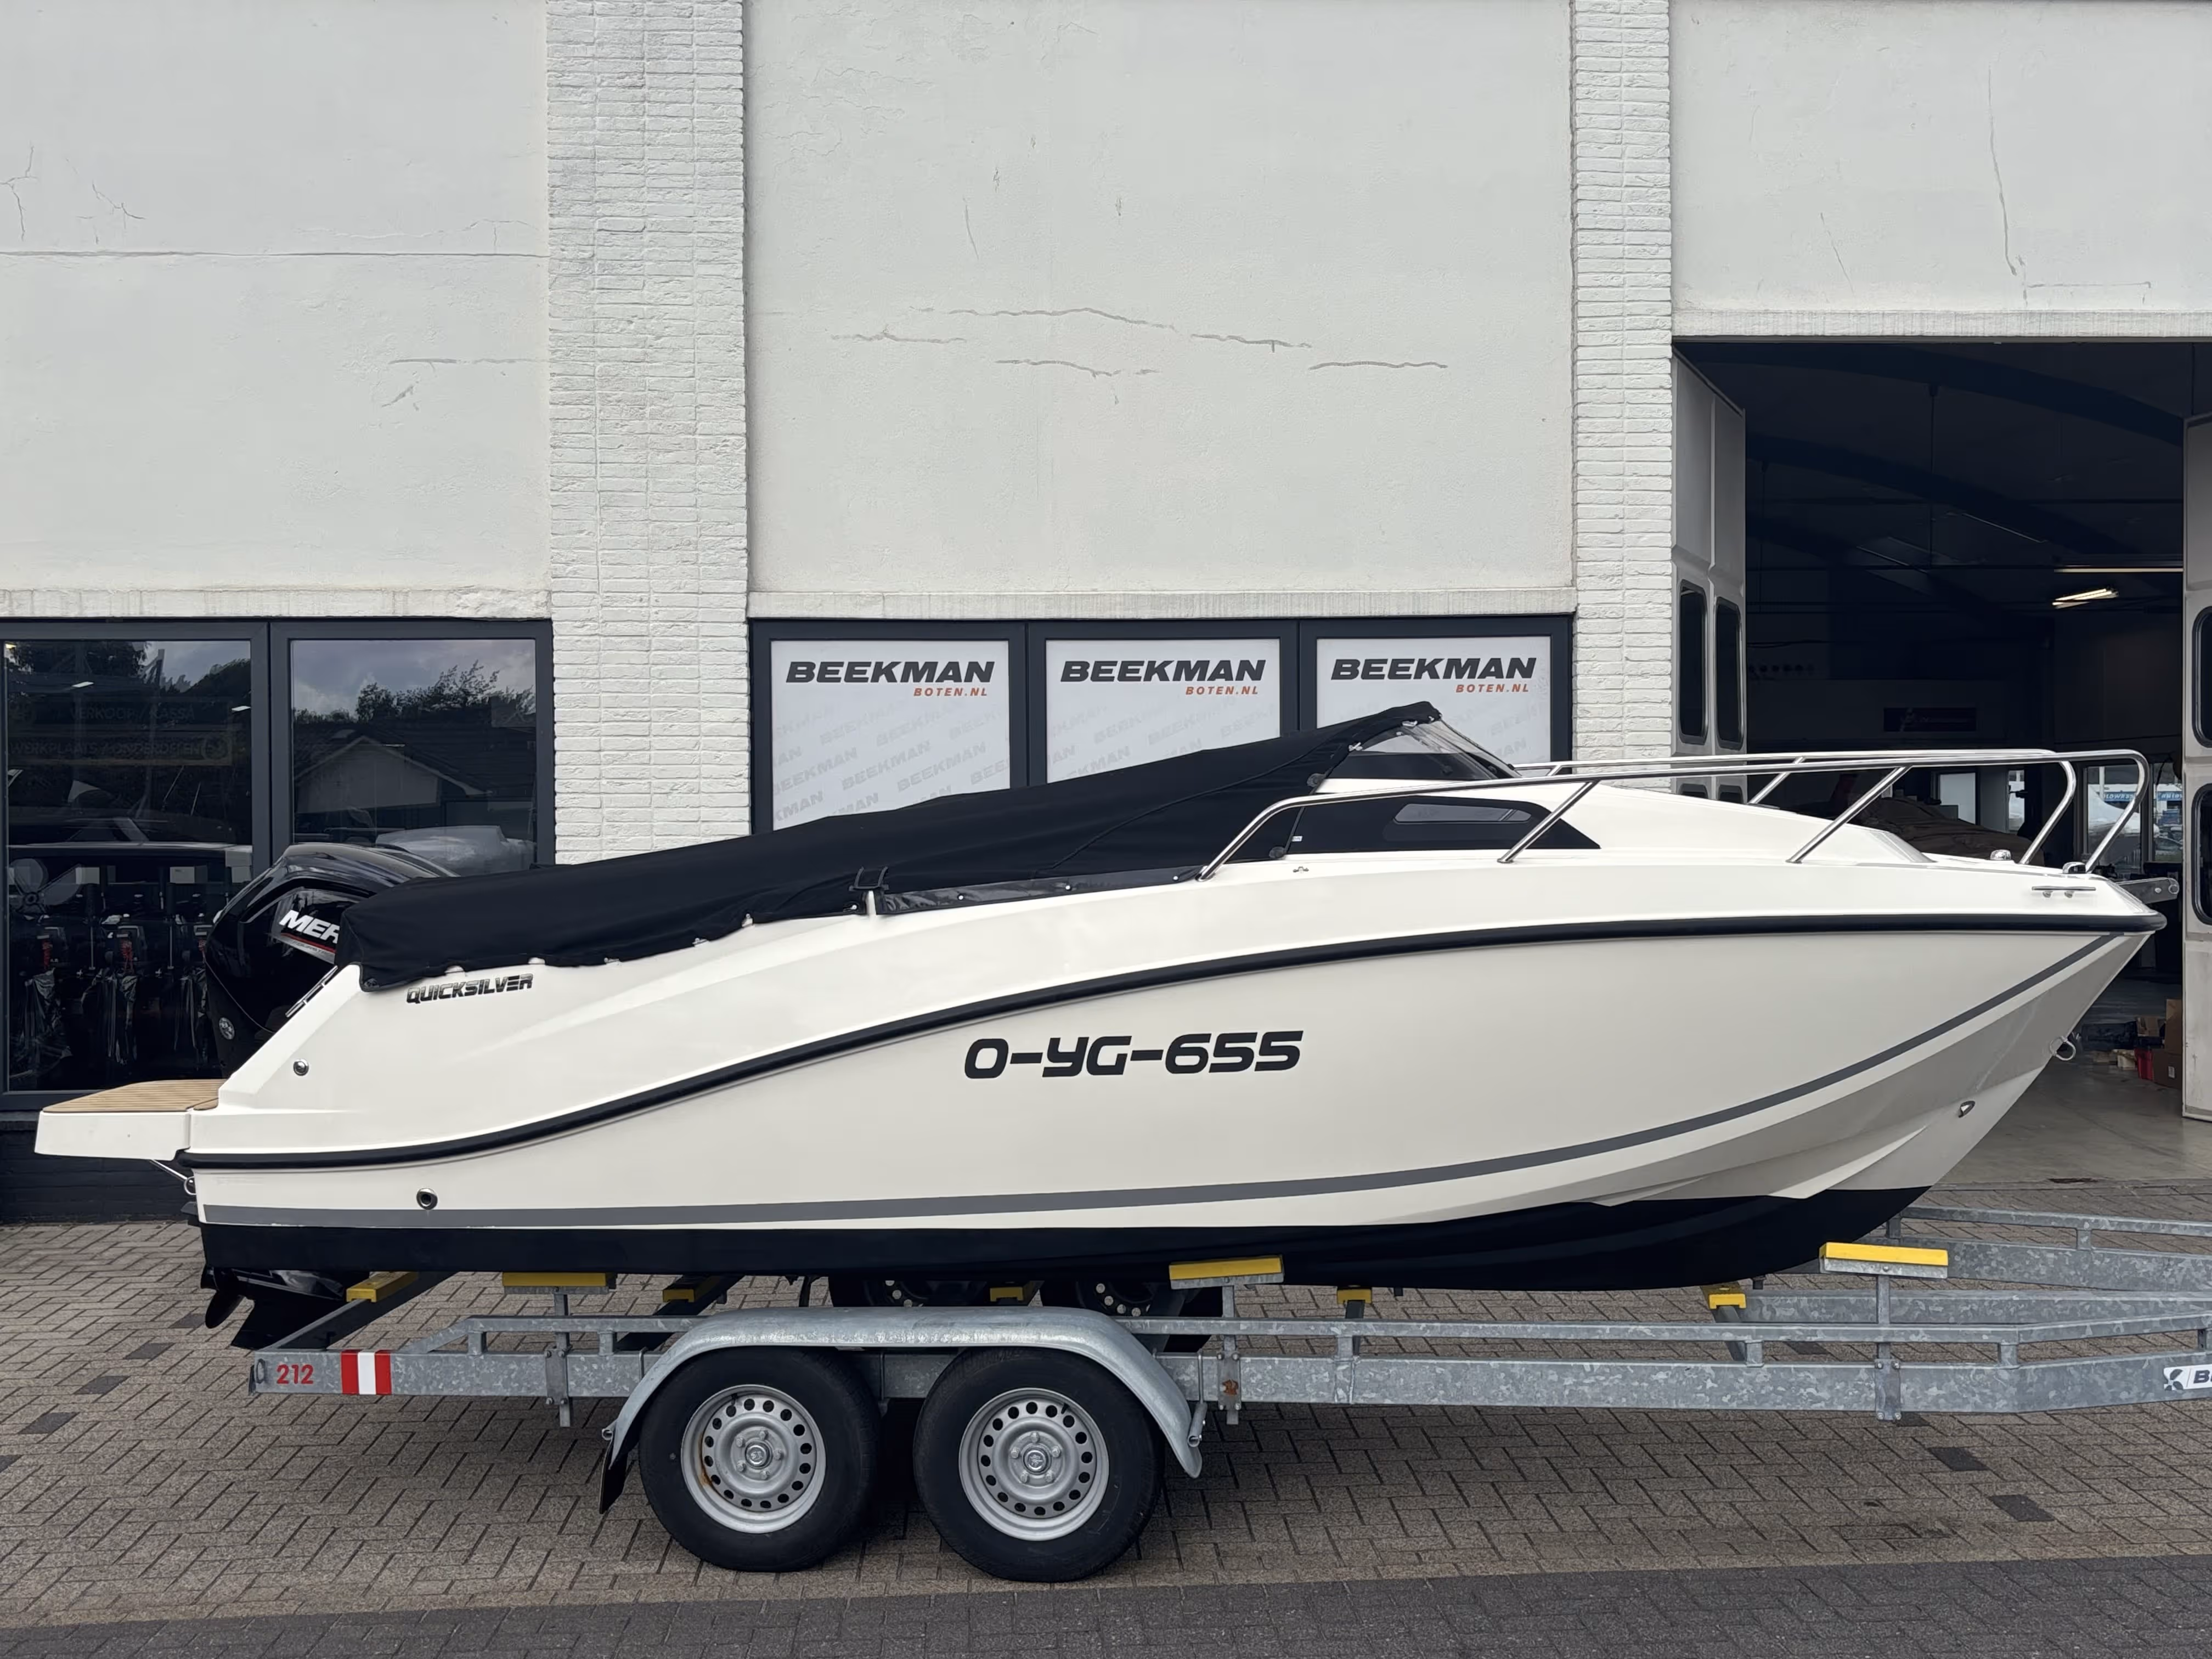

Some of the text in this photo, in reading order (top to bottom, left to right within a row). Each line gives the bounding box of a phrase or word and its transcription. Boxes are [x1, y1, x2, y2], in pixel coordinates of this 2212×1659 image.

[785, 661, 996, 684] BEEKMAN
[1060, 659, 1267, 682] BEEKMAN
[1330, 657, 1537, 680] BEEKMAN
[913, 687, 988, 697] BOTEN.NL
[1185, 686, 1259, 695] BOTEN.NL
[1455, 684, 1530, 693] BOTEN.NL
[842, 740, 930, 791] BEEKMAN
[897, 741, 986, 793] BEEKMAN
[405, 972, 533, 1005] QUICKSILVER
[964, 1030, 1304, 1079] O-YG-655
[276, 1364, 314, 1385] 212
[2193, 1369, 2212, 1384] B
